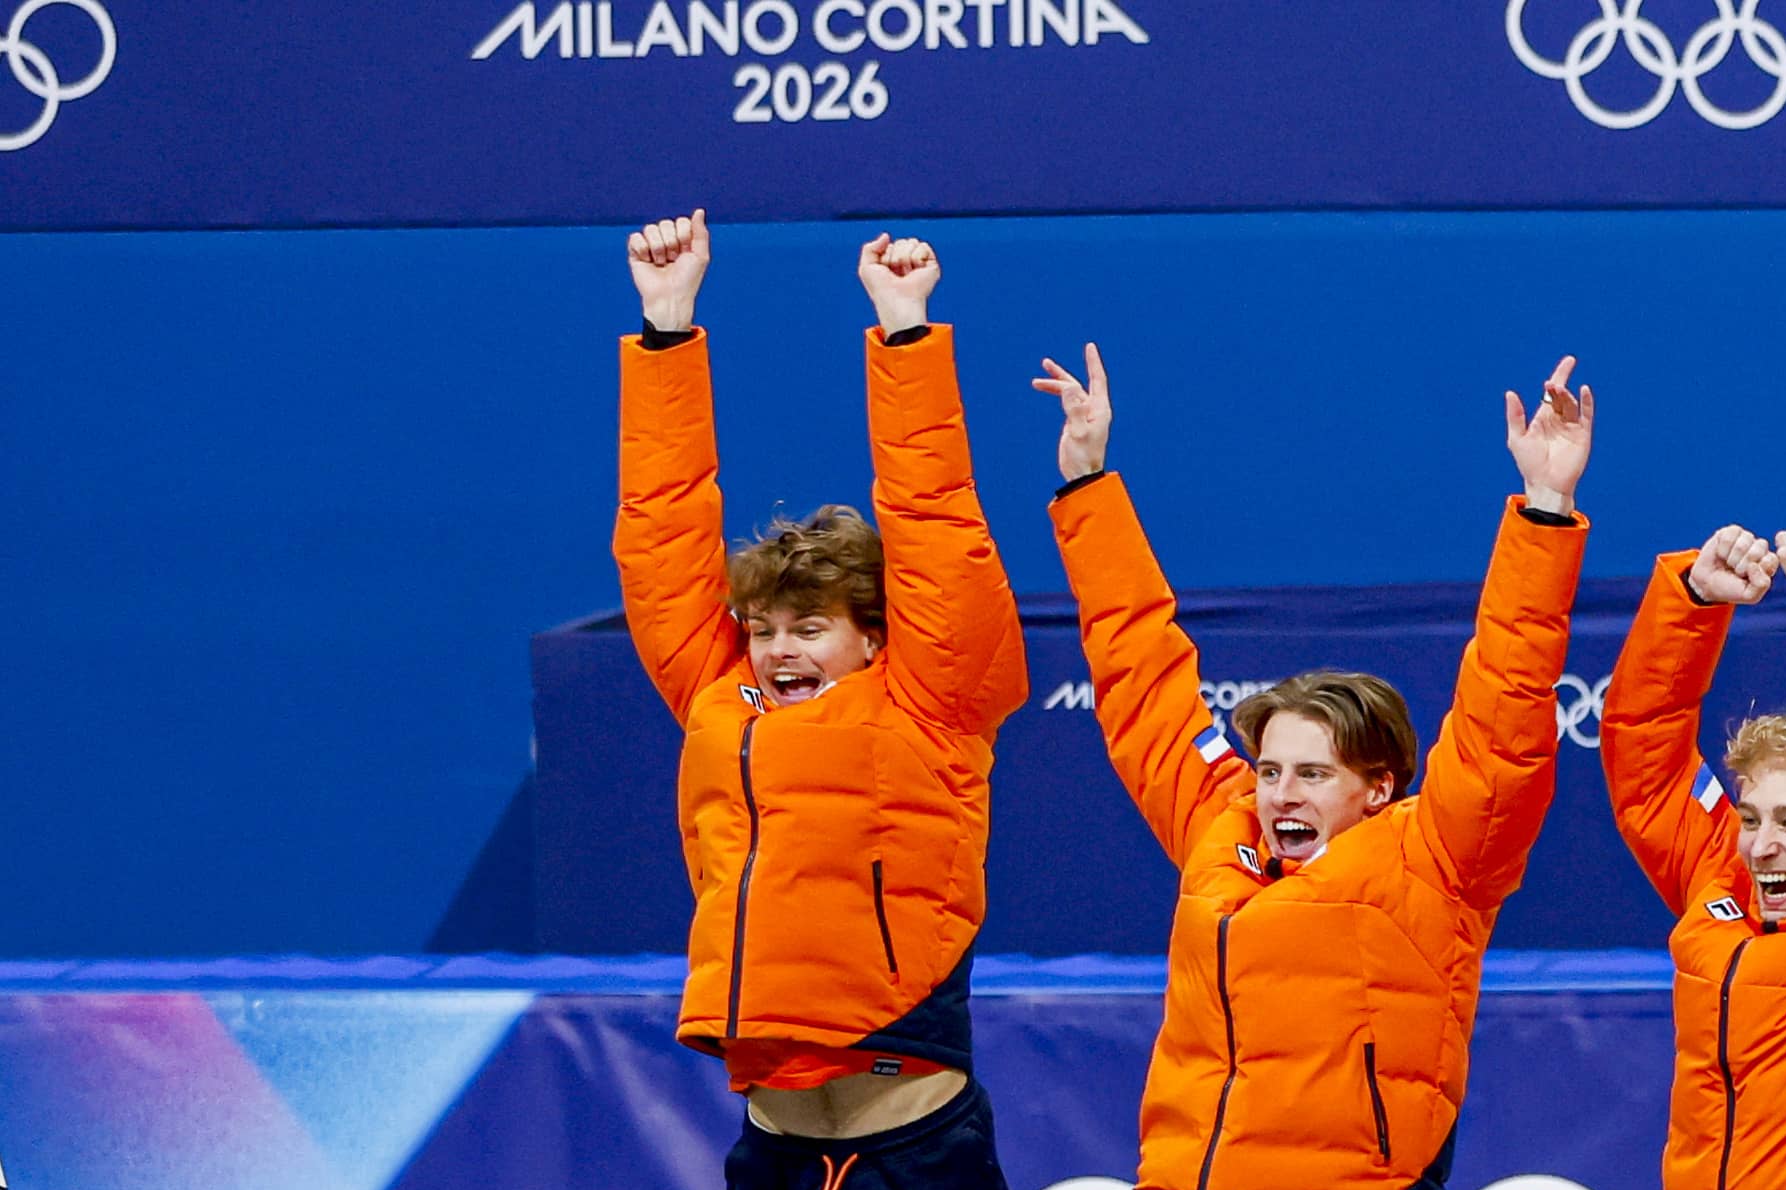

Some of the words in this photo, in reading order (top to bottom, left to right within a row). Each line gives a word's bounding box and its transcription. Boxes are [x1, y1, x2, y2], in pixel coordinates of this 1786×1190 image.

[471, 0, 799, 59] MILANO
[813, 0, 1149, 53] CORTINA
[733, 62, 889, 122] 2026
